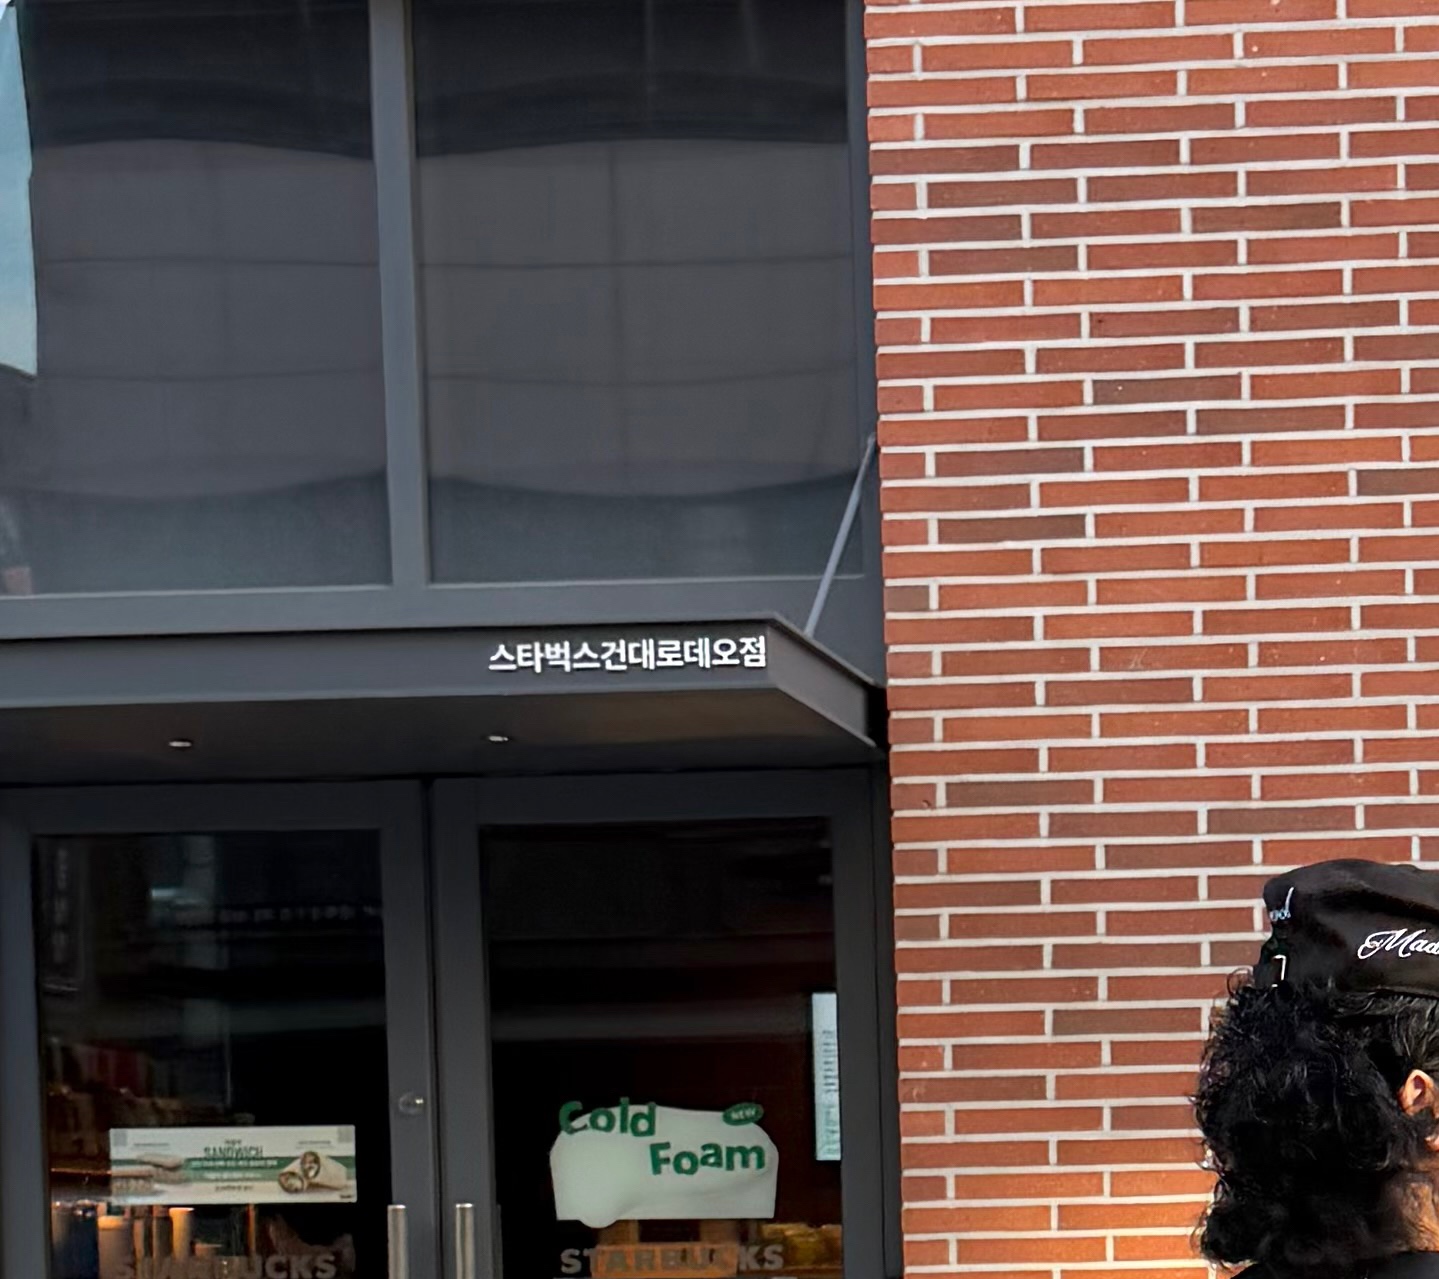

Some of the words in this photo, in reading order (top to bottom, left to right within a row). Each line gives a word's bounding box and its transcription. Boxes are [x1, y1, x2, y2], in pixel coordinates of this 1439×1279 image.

[488, 635, 766, 672] 스타벅스건대로데오점
[559, 1097, 657, 1137] Cold
[203, 1147, 264, 1158] SANDWICH
[650, 1141, 766, 1175] Foam
